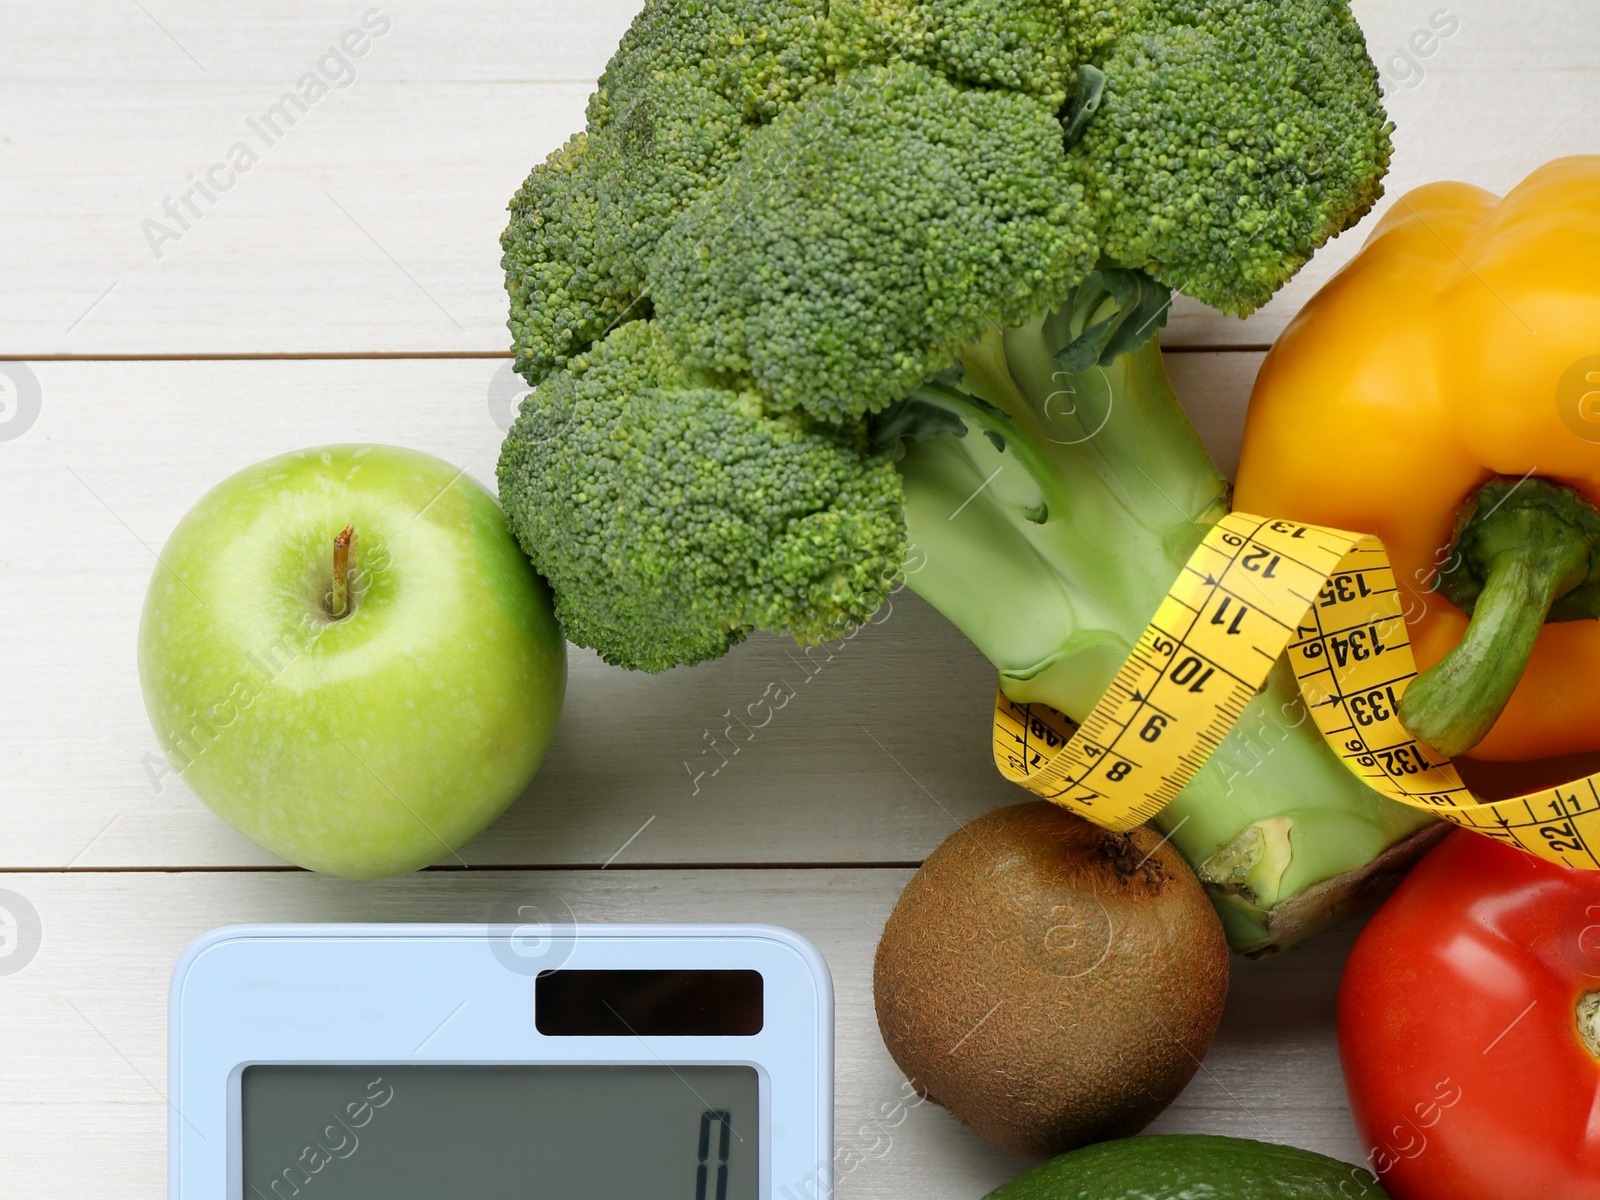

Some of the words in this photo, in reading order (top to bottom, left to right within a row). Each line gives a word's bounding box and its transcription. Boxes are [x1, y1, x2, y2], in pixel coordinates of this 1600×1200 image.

[1269, 520, 1307, 540] 13
[1241, 544, 1282, 579] 12
[1318, 573, 1371, 608] 135
[1210, 596, 1248, 635] 11
[1152, 636, 1175, 657] 5
[1331, 626, 1385, 668] 134
[1170, 656, 1216, 694] 10
[1350, 686, 1399, 727] 133
[1083, 742, 1102, 759] 4
[1377, 745, 1430, 776] 132
[1105, 760, 1133, 782] 8
[1539, 822, 1583, 852] 22
